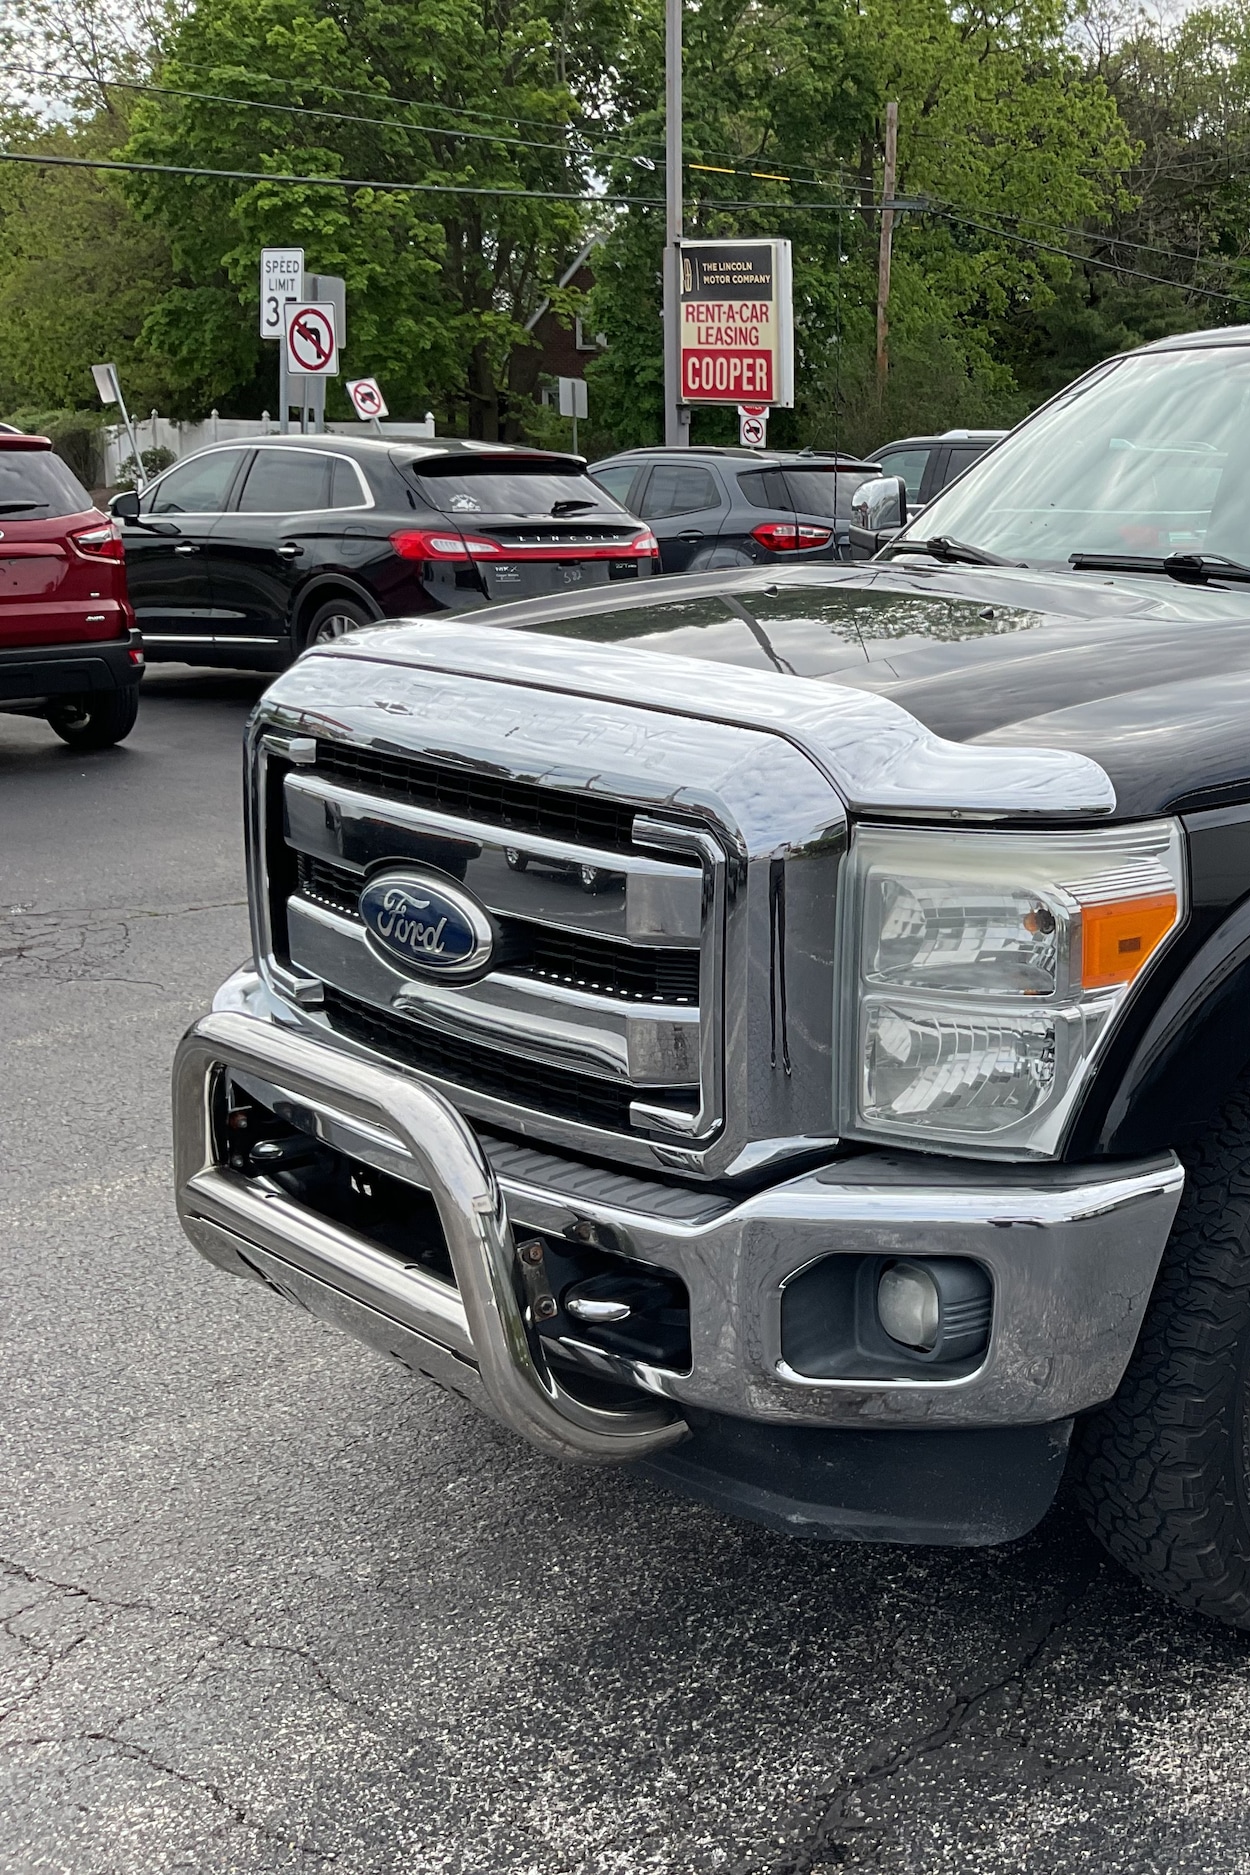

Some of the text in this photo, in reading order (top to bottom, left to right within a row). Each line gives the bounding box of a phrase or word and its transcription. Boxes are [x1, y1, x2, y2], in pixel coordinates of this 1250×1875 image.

[265, 260, 300, 274] SPEED
[702, 262, 753, 272] THE LINCOLN
[268, 278, 295, 292] LIMIT
[703, 275, 771, 285] MOTOR COMPANY
[685, 303, 770, 323] RENT-A-CAR
[697, 326, 759, 346] LEASING
[687, 357, 768, 392] COOPER
[377, 888, 448, 953] Ford
